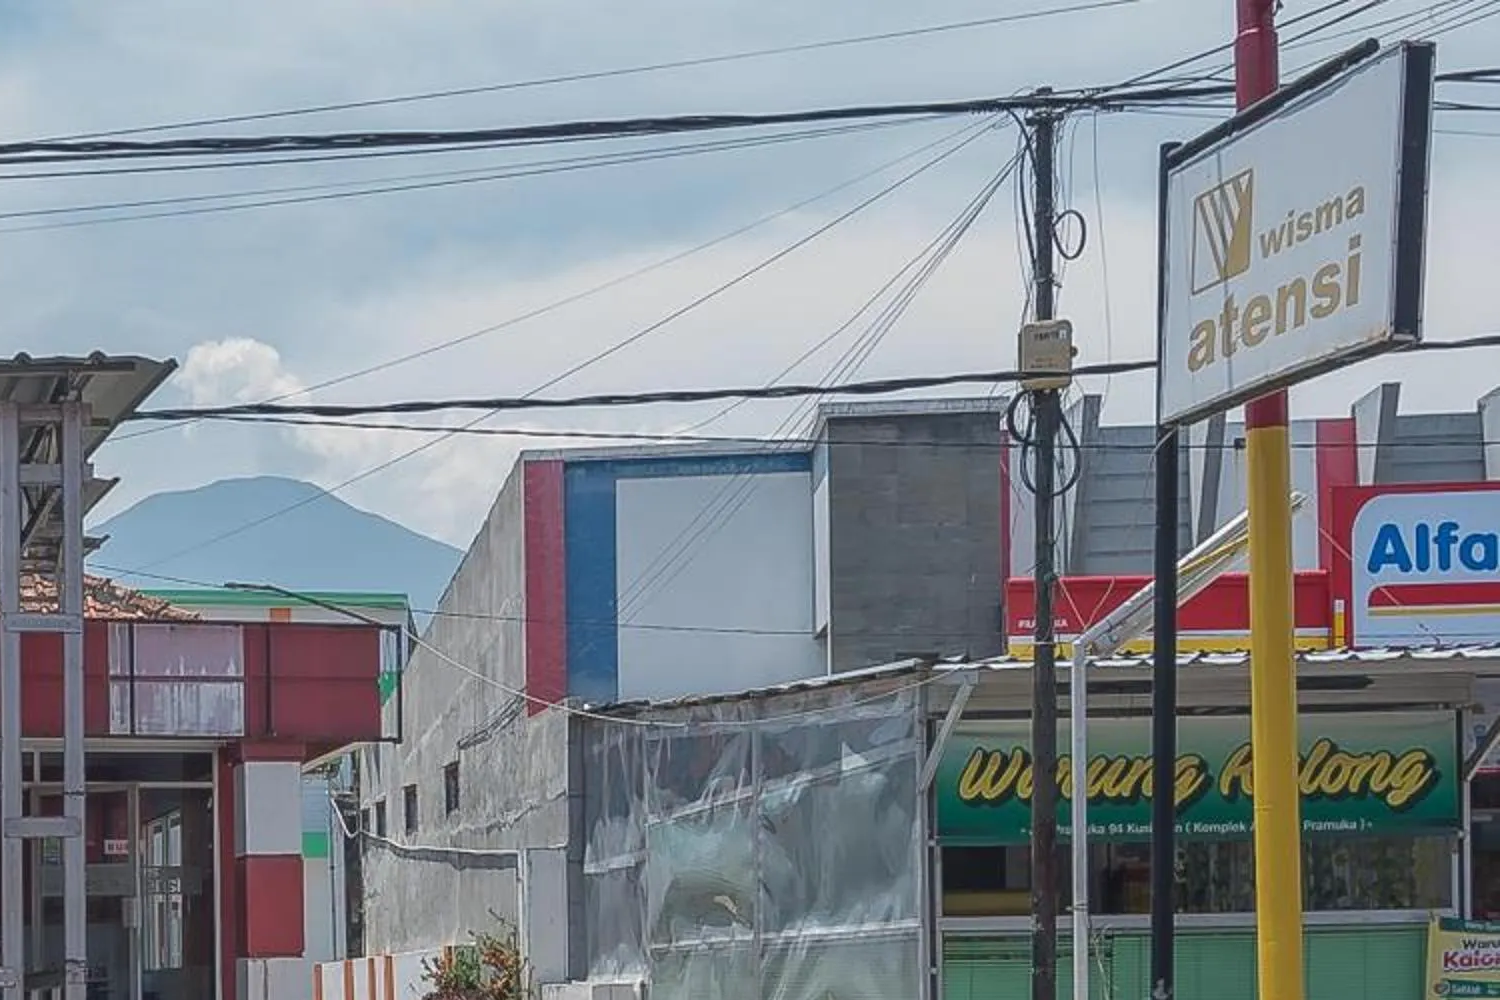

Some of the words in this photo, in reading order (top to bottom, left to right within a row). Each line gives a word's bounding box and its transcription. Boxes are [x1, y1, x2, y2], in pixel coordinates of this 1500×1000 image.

[1259, 186, 1366, 259] wisma
[1187, 233, 1361, 373] atensi
[1366, 521, 1500, 574] Alfa
[1219, 738, 1434, 807] Klong
[1303, 819, 1357, 831] Pramuka
